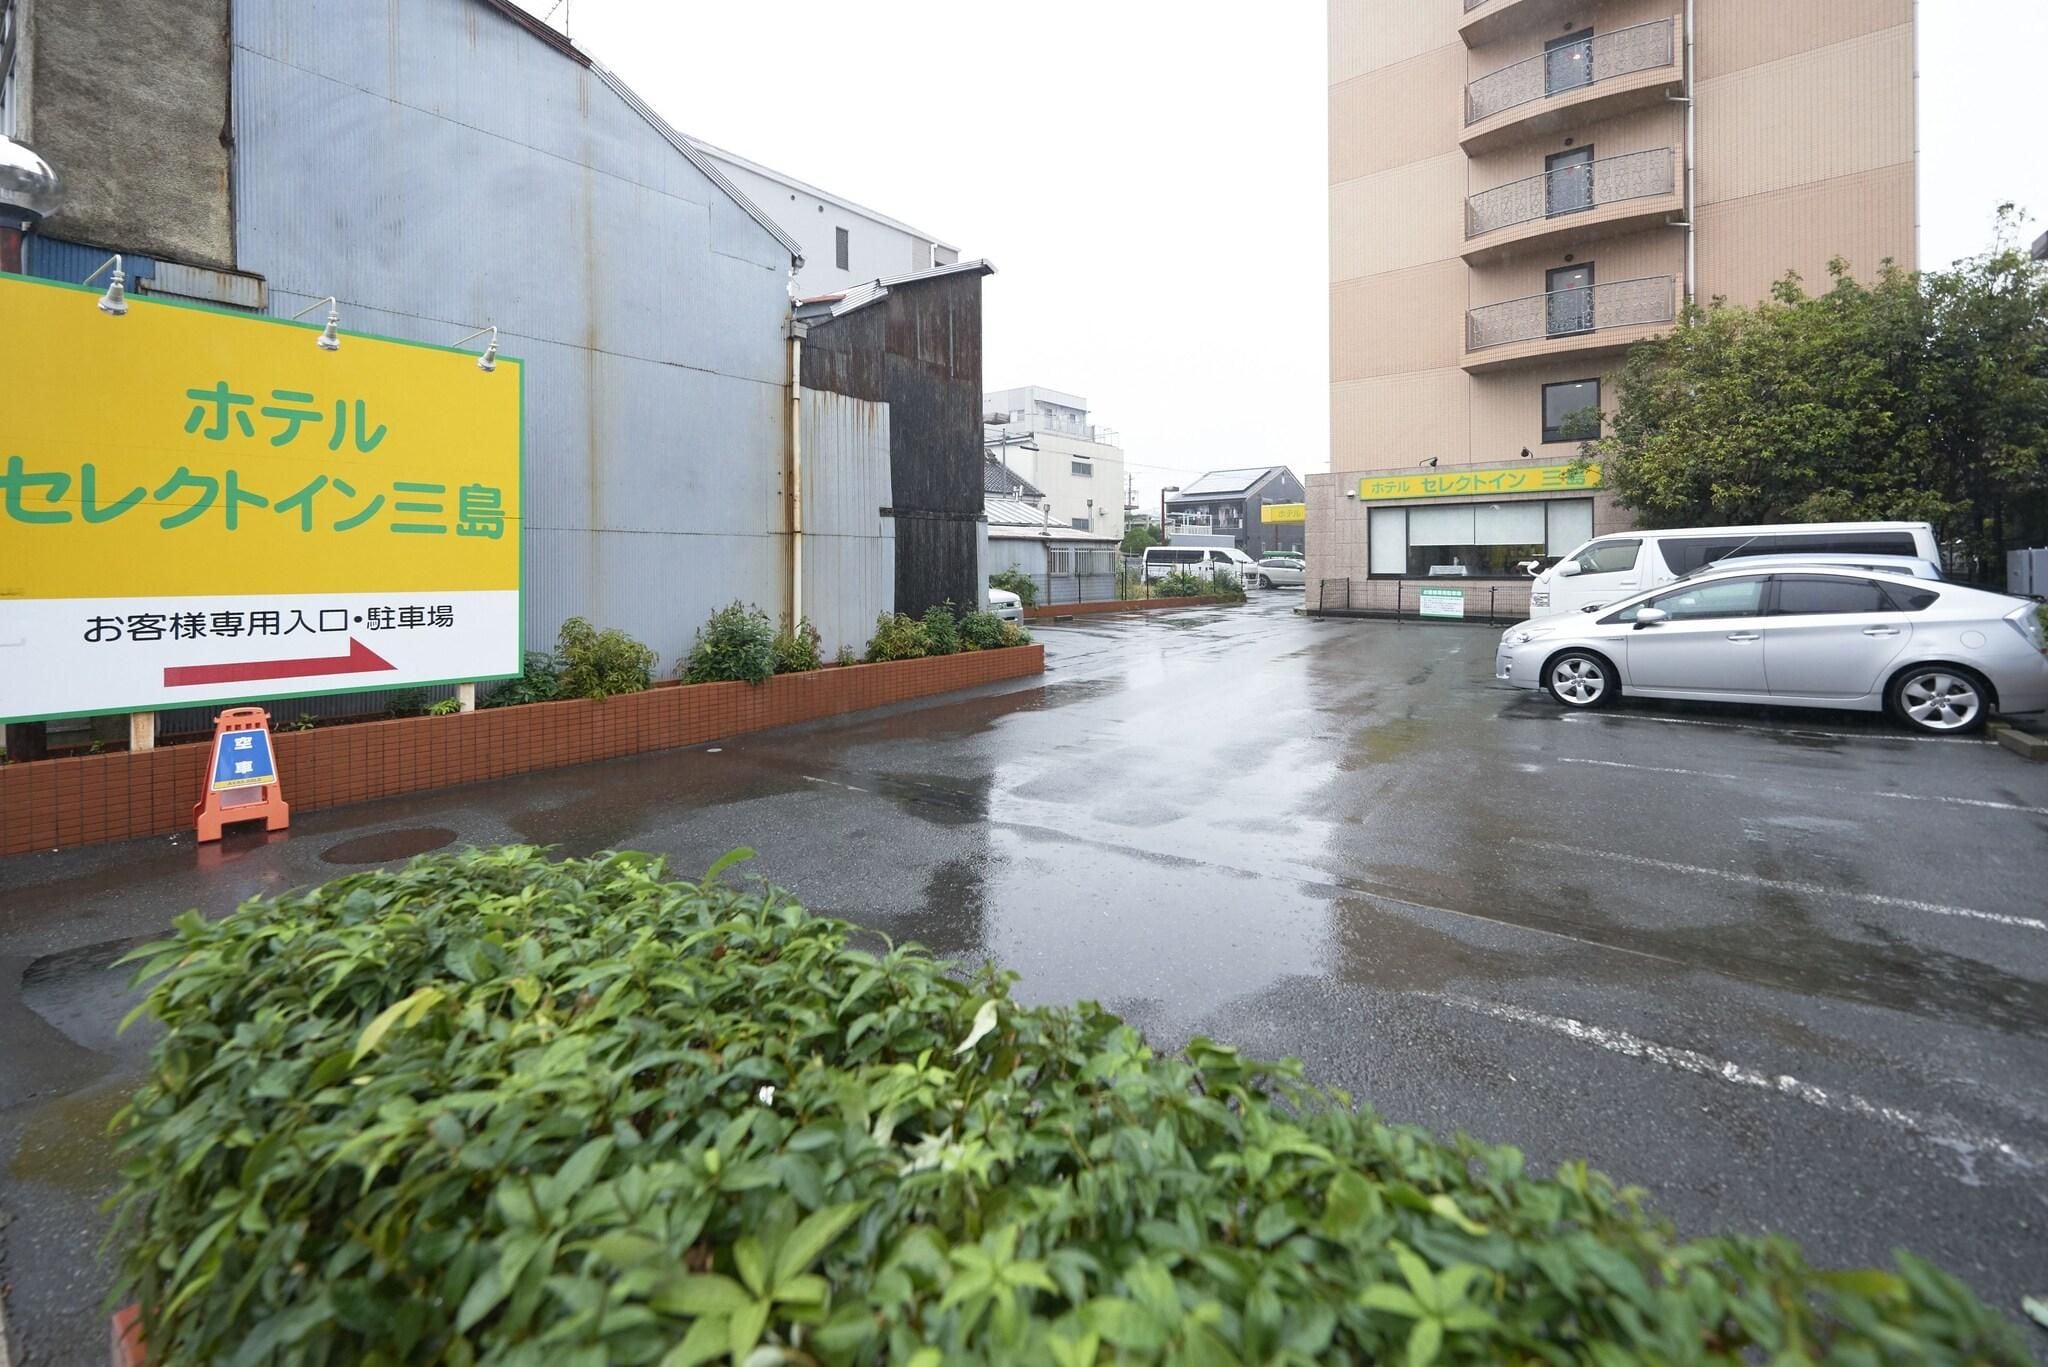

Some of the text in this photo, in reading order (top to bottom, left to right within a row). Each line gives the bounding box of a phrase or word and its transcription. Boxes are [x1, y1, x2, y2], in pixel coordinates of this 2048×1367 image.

[184, 380, 387, 453] ホテル
[0, 455, 506, 540] セレクトイン三島
[1371, 481, 1410, 494] ホテル
[1421, 473, 1526, 493] セレクトイン
[83, 604, 454, 643] お客様専用入口・駐車場
[234, 736, 254, 775] 空車
